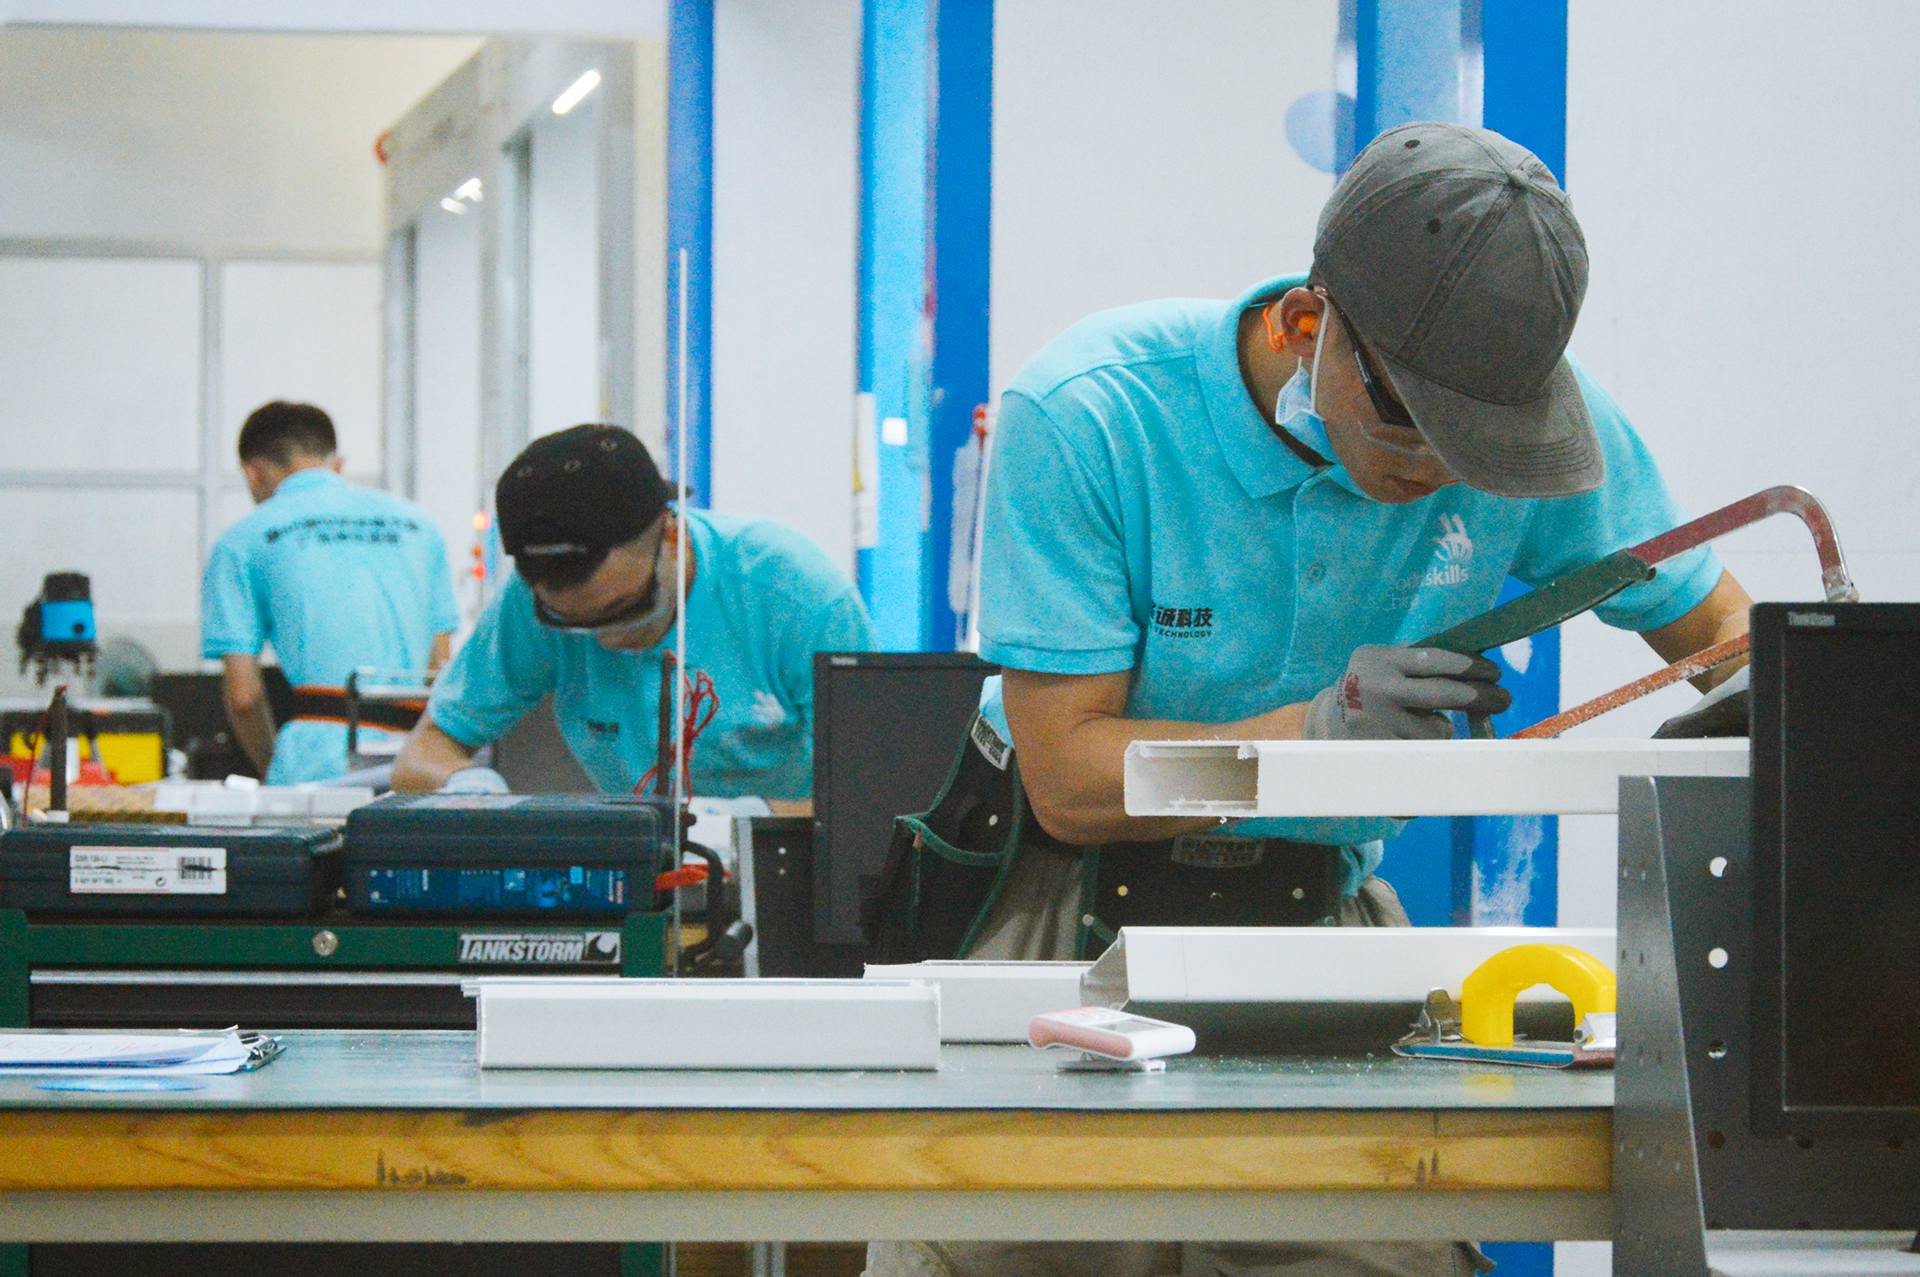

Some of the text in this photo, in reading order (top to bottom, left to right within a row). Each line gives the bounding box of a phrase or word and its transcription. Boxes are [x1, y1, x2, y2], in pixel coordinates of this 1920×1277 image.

[1151, 602, 1213, 627] 诚科技
[459, 934, 584, 961] TANKSTORM
